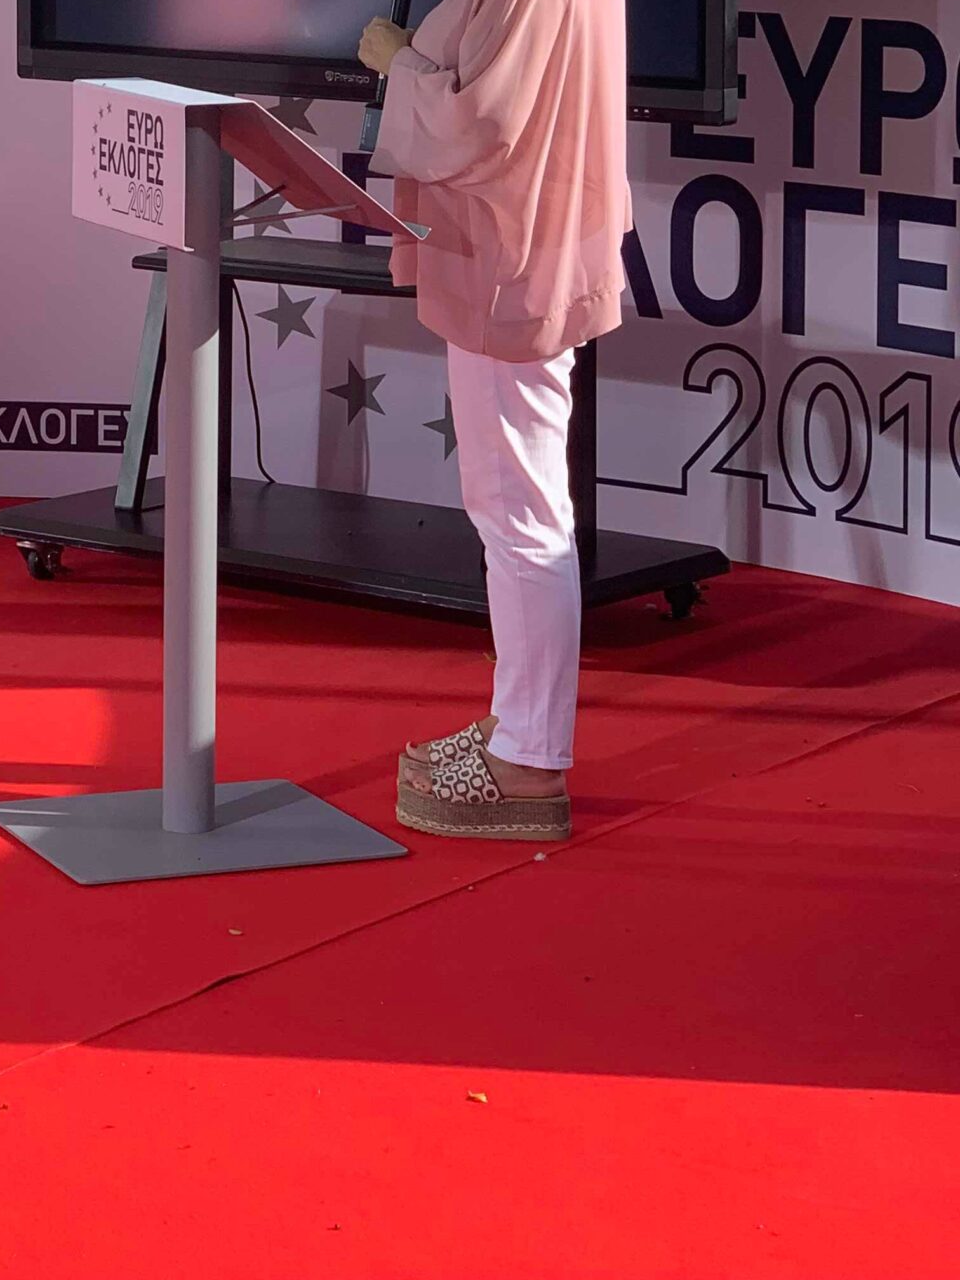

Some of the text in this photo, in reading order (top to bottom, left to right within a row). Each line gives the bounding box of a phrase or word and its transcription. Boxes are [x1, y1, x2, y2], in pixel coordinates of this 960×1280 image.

[126, 109, 164, 150] ΕΥΡΩ
[98, 137, 164, 186] ΕΚΛΟΓΕΣ
[127, 181, 164, 225] 2019
[682, 342, 960, 547] 201
